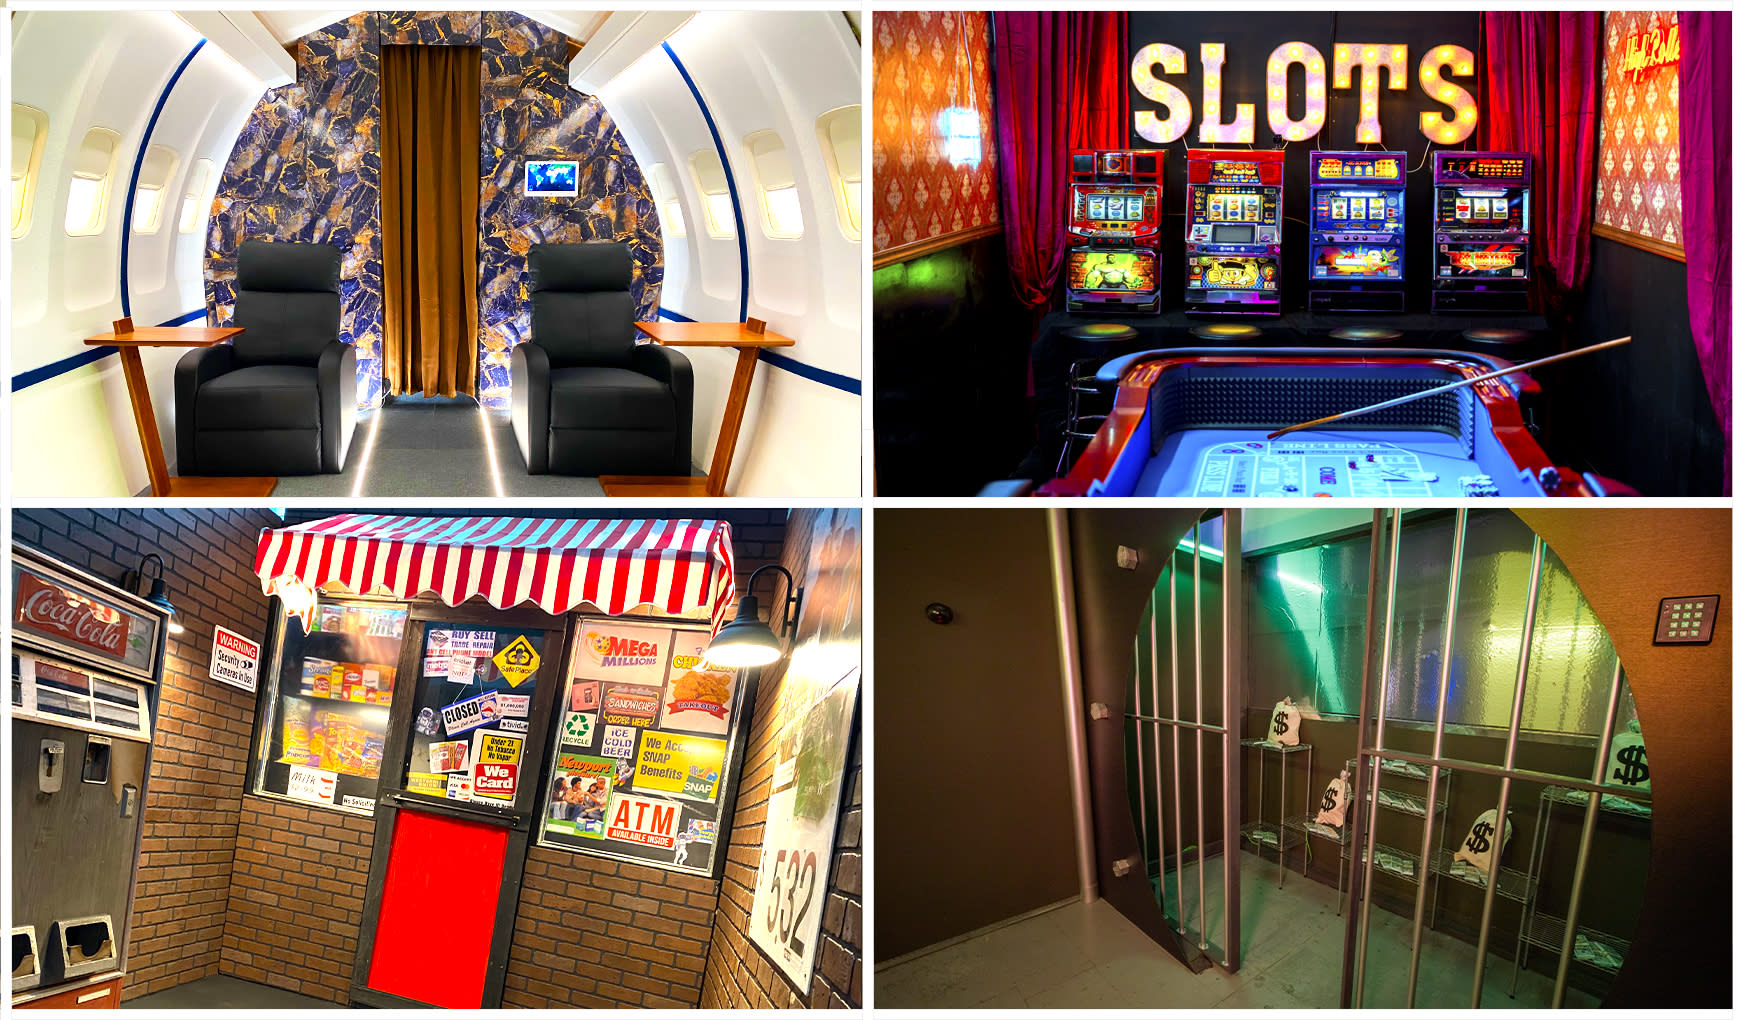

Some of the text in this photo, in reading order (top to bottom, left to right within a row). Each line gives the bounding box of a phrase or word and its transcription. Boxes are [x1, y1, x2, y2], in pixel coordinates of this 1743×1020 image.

[1131, 41, 1478, 144] SLOTS
[474, 631, 494, 640] SELL
[220, 632, 256, 658] WARNING
[608, 636, 657, 657] MEGA
[218, 649, 239, 669] Security
[601, 656, 656, 667] MILLIONS
[216, 663, 238, 680] Cameras
[608, 697, 656, 713] SANDWICHES
[678, 702, 719, 712] TAKEOUT
[445, 701, 479, 724] CLOSED
[607, 715, 651, 728] ORDER HERE
[1273, 710, 1289, 736] $
[611, 729, 629, 738] ICE
[496, 746, 515, 754] Tobacco
[604, 738, 632, 748] COLD
[646, 737, 661, 749] We
[603, 747, 631, 757] BEER
[643, 751, 670, 764] SNAP
[484, 765, 509, 777] We
[558, 756, 612, 774] Newport
[640, 764, 683, 780] Benefits
[291, 771, 316, 785] Milk
[476, 776, 514, 789] Card
[683, 782, 713, 794] SNAP
[352, 798, 376, 808] Solicitin
[1321, 786, 1337, 813] $
[613, 799, 675, 836] ATM
[611, 830, 669, 846] AVAILABLE INSIDE
[1466, 822, 1493, 855] $
